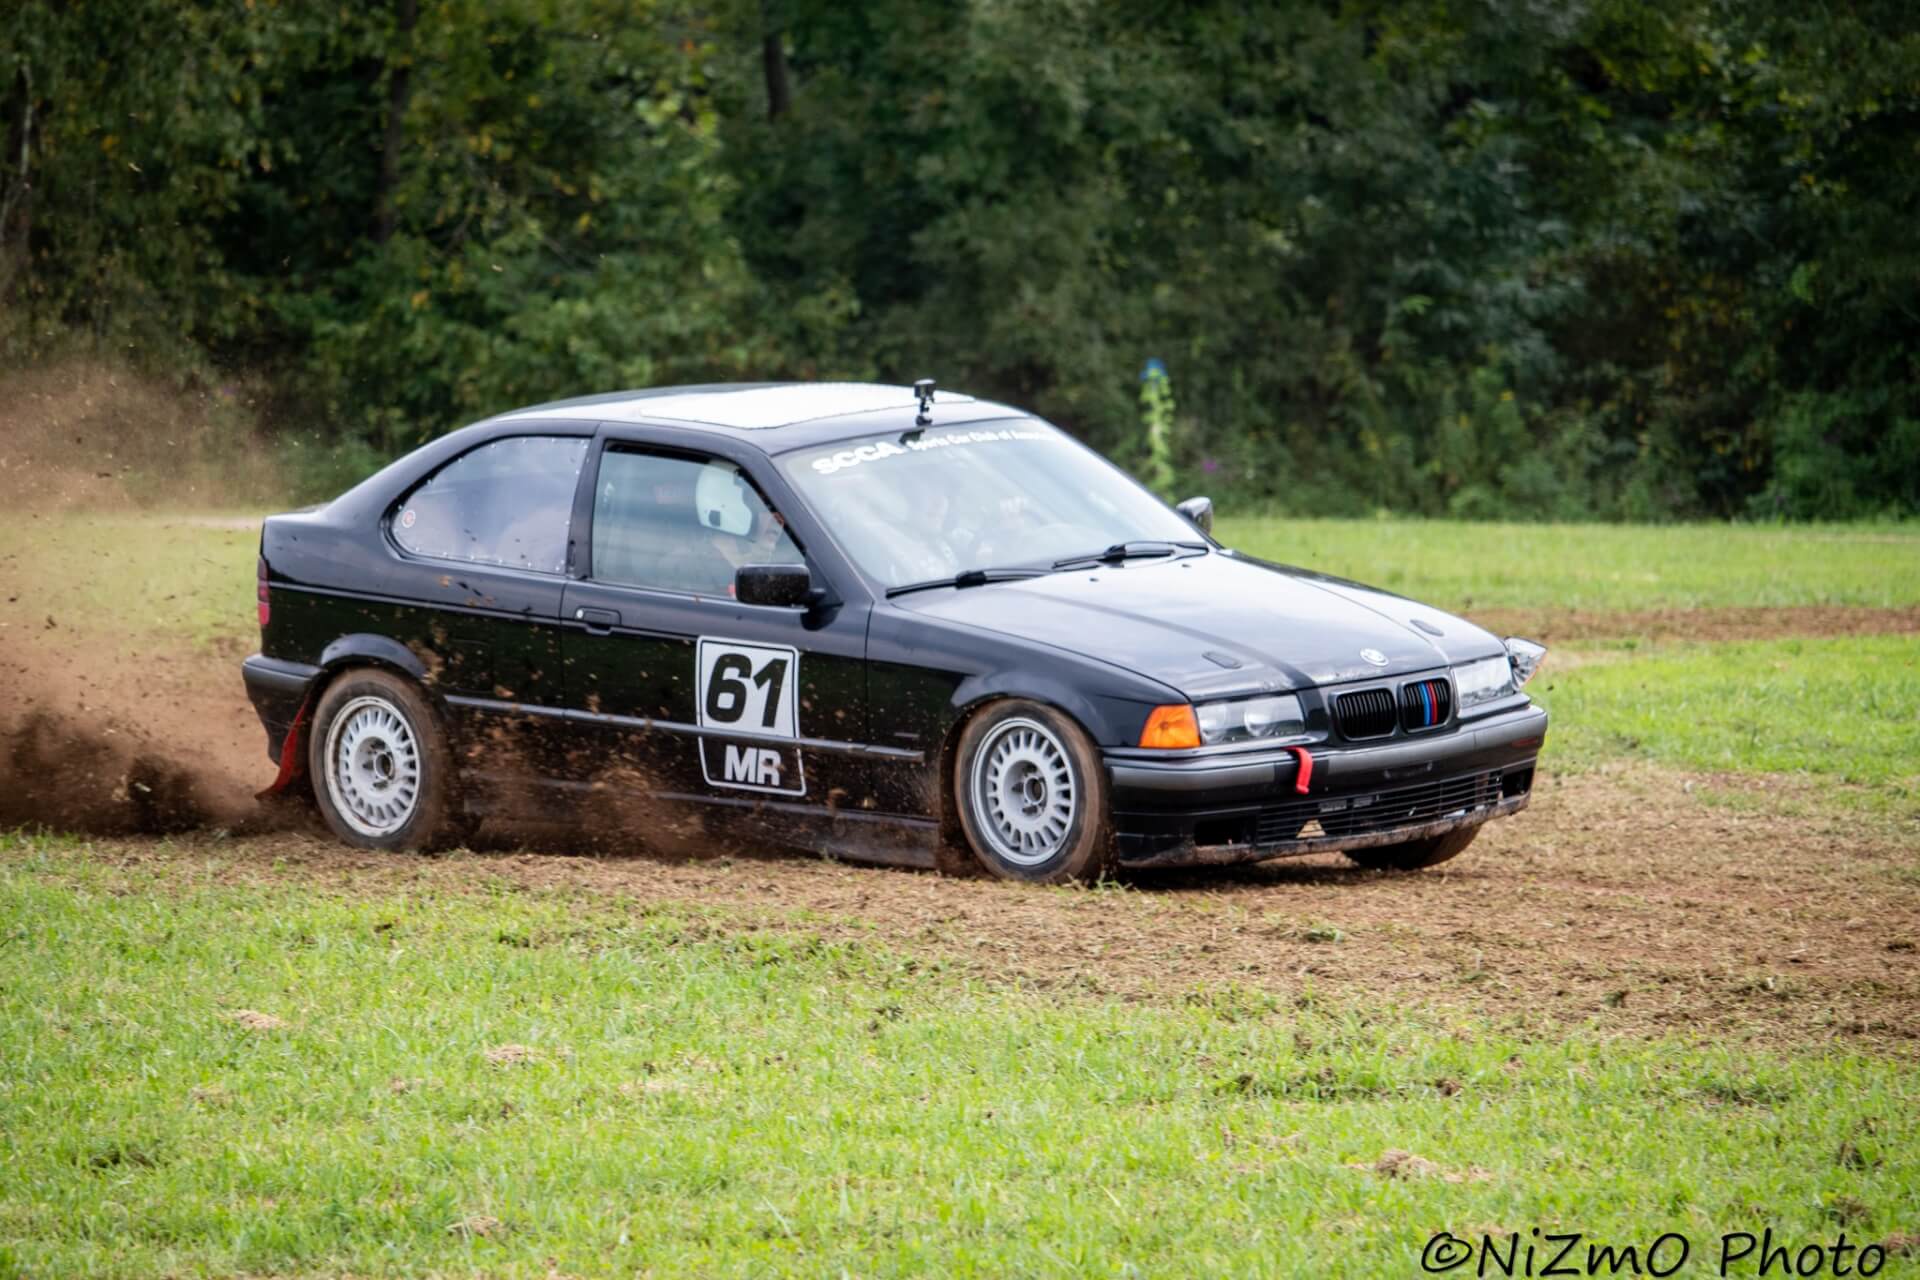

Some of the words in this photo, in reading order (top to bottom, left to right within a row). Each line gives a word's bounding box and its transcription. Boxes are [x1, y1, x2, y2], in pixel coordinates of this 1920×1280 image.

[812, 441, 905, 474] SCCA
[706, 653, 788, 728] 61
[724, 744, 782, 786] MR
